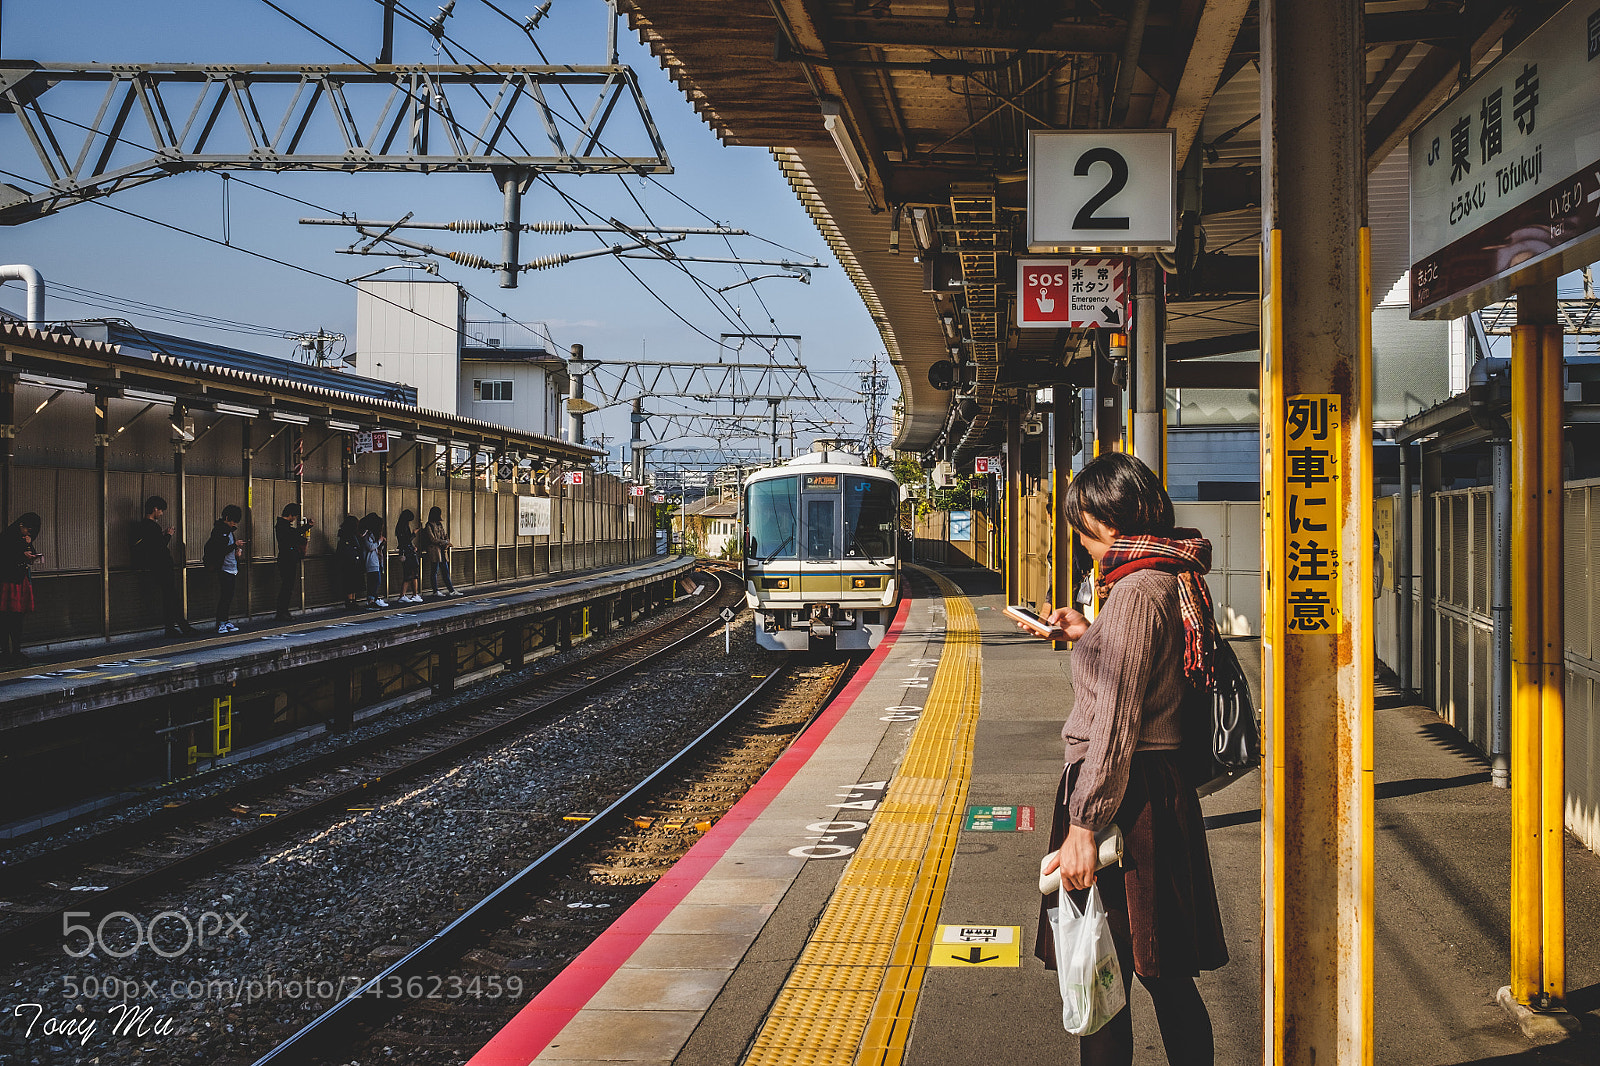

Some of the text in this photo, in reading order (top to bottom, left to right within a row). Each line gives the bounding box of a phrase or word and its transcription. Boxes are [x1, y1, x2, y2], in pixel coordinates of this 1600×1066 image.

[1428, 63, 1540, 187] JR 東福寺
[1072, 147, 1130, 230] 2
[1450, 180, 1487, 226] とうふくじ
[1549, 182, 1582, 219] いなり
[1028, 273, 1064, 287] SOS
[1072, 268, 1109, 280] 非常
[1417, 261, 1439, 287] きょうと
[1072, 281, 1109, 293] ボタン
[1071, 295, 1110, 304] Emergency
[1071, 303, 1095, 311] Button
[854, 482, 872, 492] JR
[1287, 398, 1330, 631] 列車に注意
